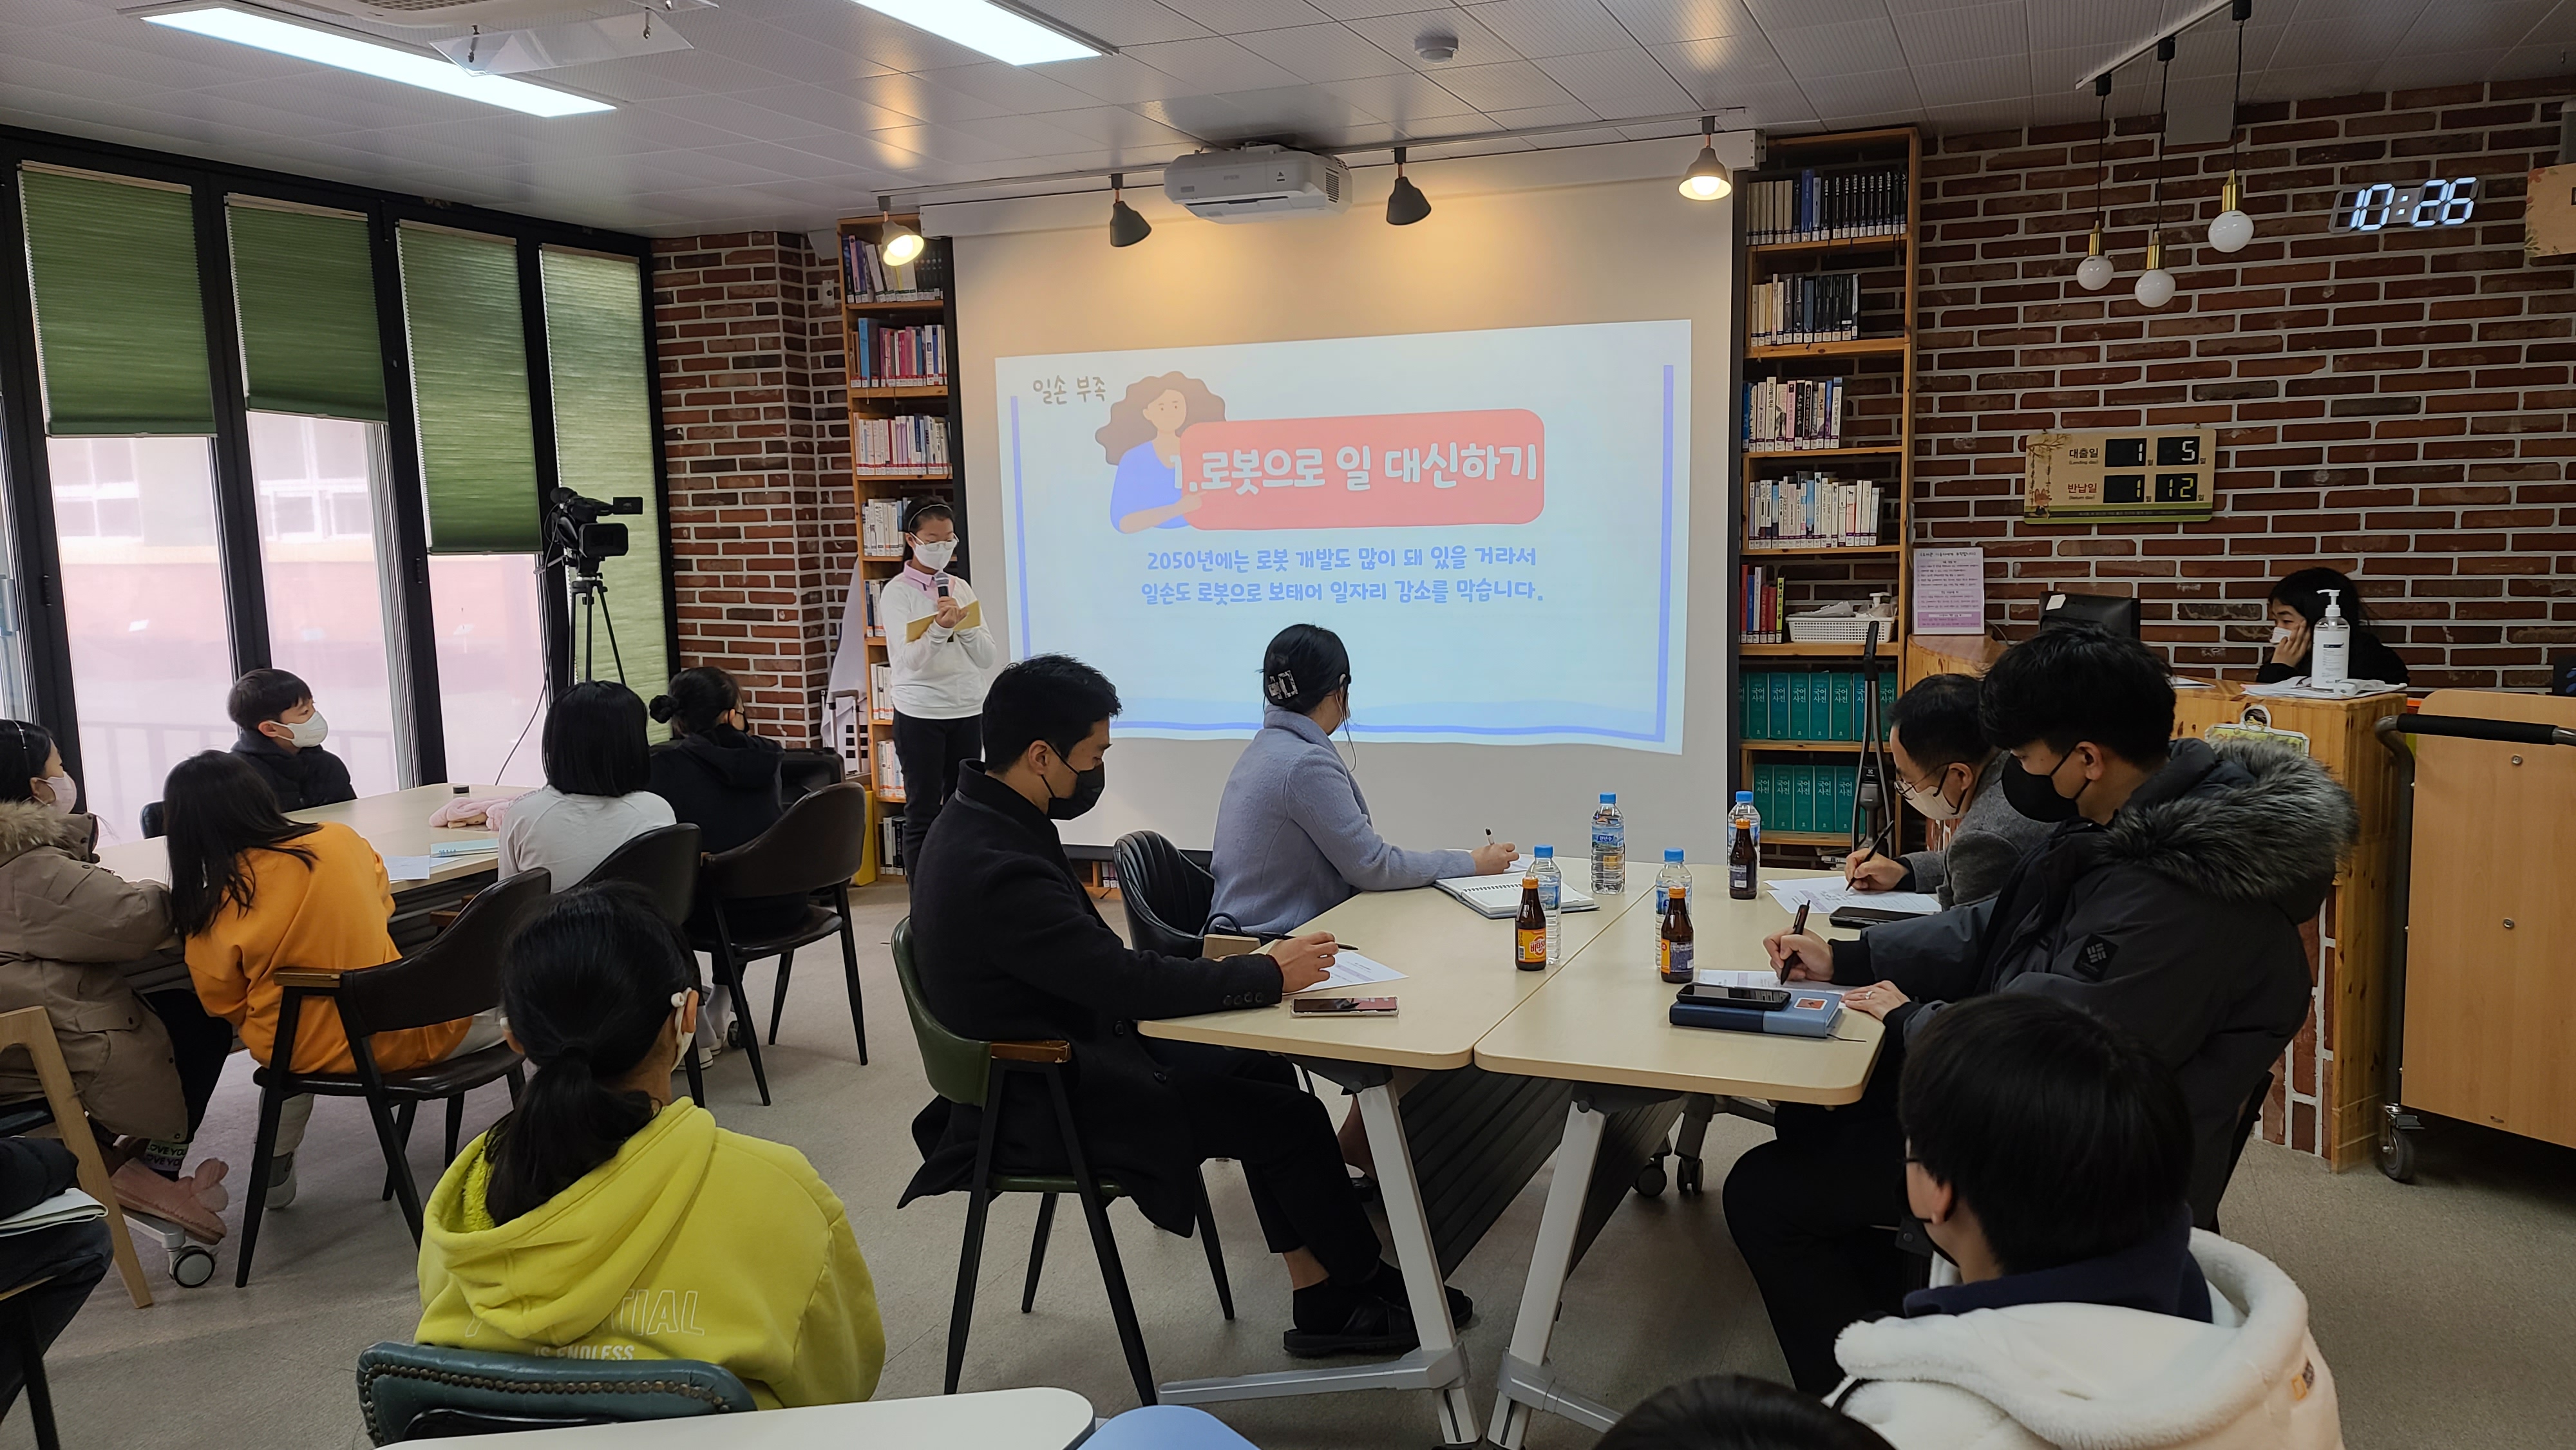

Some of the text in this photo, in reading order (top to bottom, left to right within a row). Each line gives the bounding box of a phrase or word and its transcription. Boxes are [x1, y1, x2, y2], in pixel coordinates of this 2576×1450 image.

[2350, 176, 2477, 231] 10:26
[1033, 375, 1106, 405] 일손 부족
[2069, 447, 2099, 459] 대출일
[2138, 443, 2143, 462] 1
[2181, 440, 2195, 461] 5
[1170, 442, 1537, 495] 1.로봇으로 일 대신하기
[2067, 483, 2097, 494] 반납일
[2136, 479, 2141, 498] 1
[2168, 477, 2193, 498] 12
[1148, 545, 1536, 573] 2050년에는 로봇 개발도 많이 돼 있을 거라서
[1141, 578, 1543, 605] 일손도 로봇으로 보태어 일자리 감소를 막습니다.
[556, 1344, 634, 1360] ENDLESS
